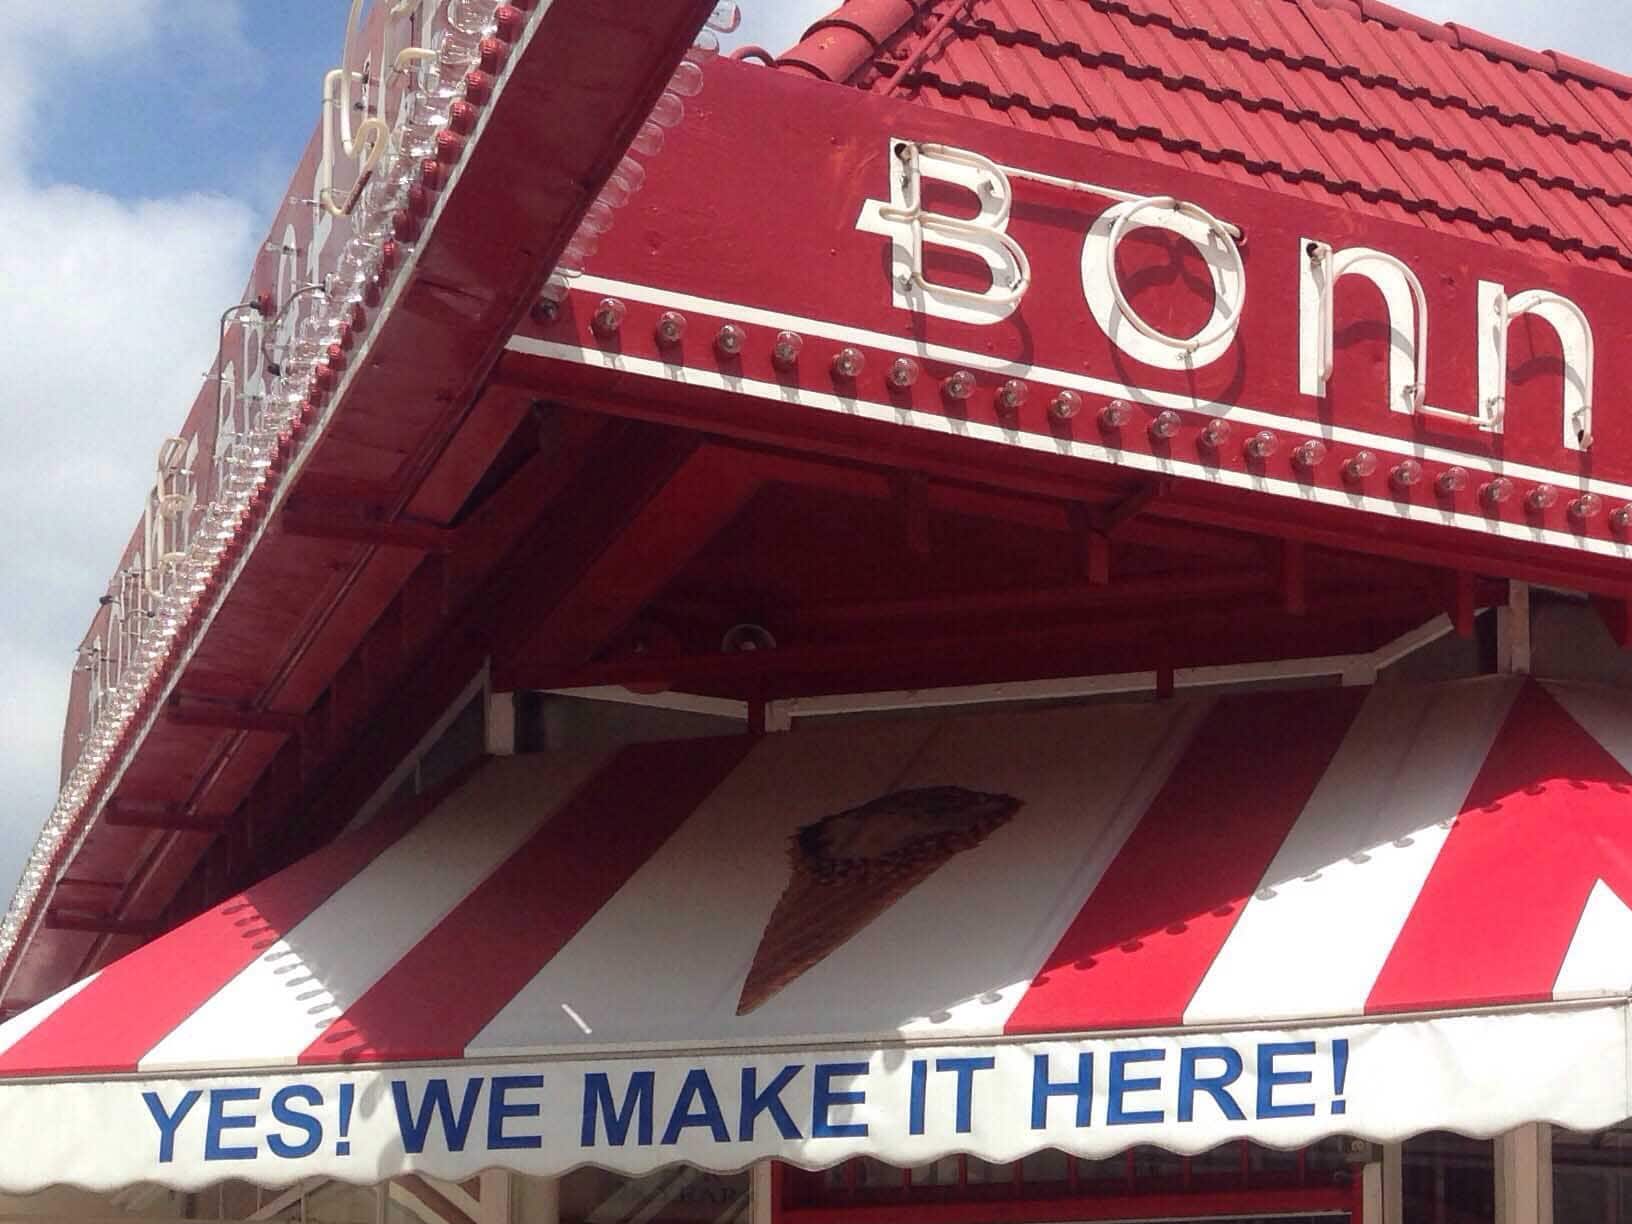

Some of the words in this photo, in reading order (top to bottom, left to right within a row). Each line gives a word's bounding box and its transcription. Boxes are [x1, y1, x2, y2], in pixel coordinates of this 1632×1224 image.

[142, 1083, 355, 1163] YES!
[391, 1074, 545, 1154] WE
[579, 1061, 870, 1148] MAKE
[909, 1056, 996, 1136] IT
[1030, 1038, 1350, 1131] HERE!
